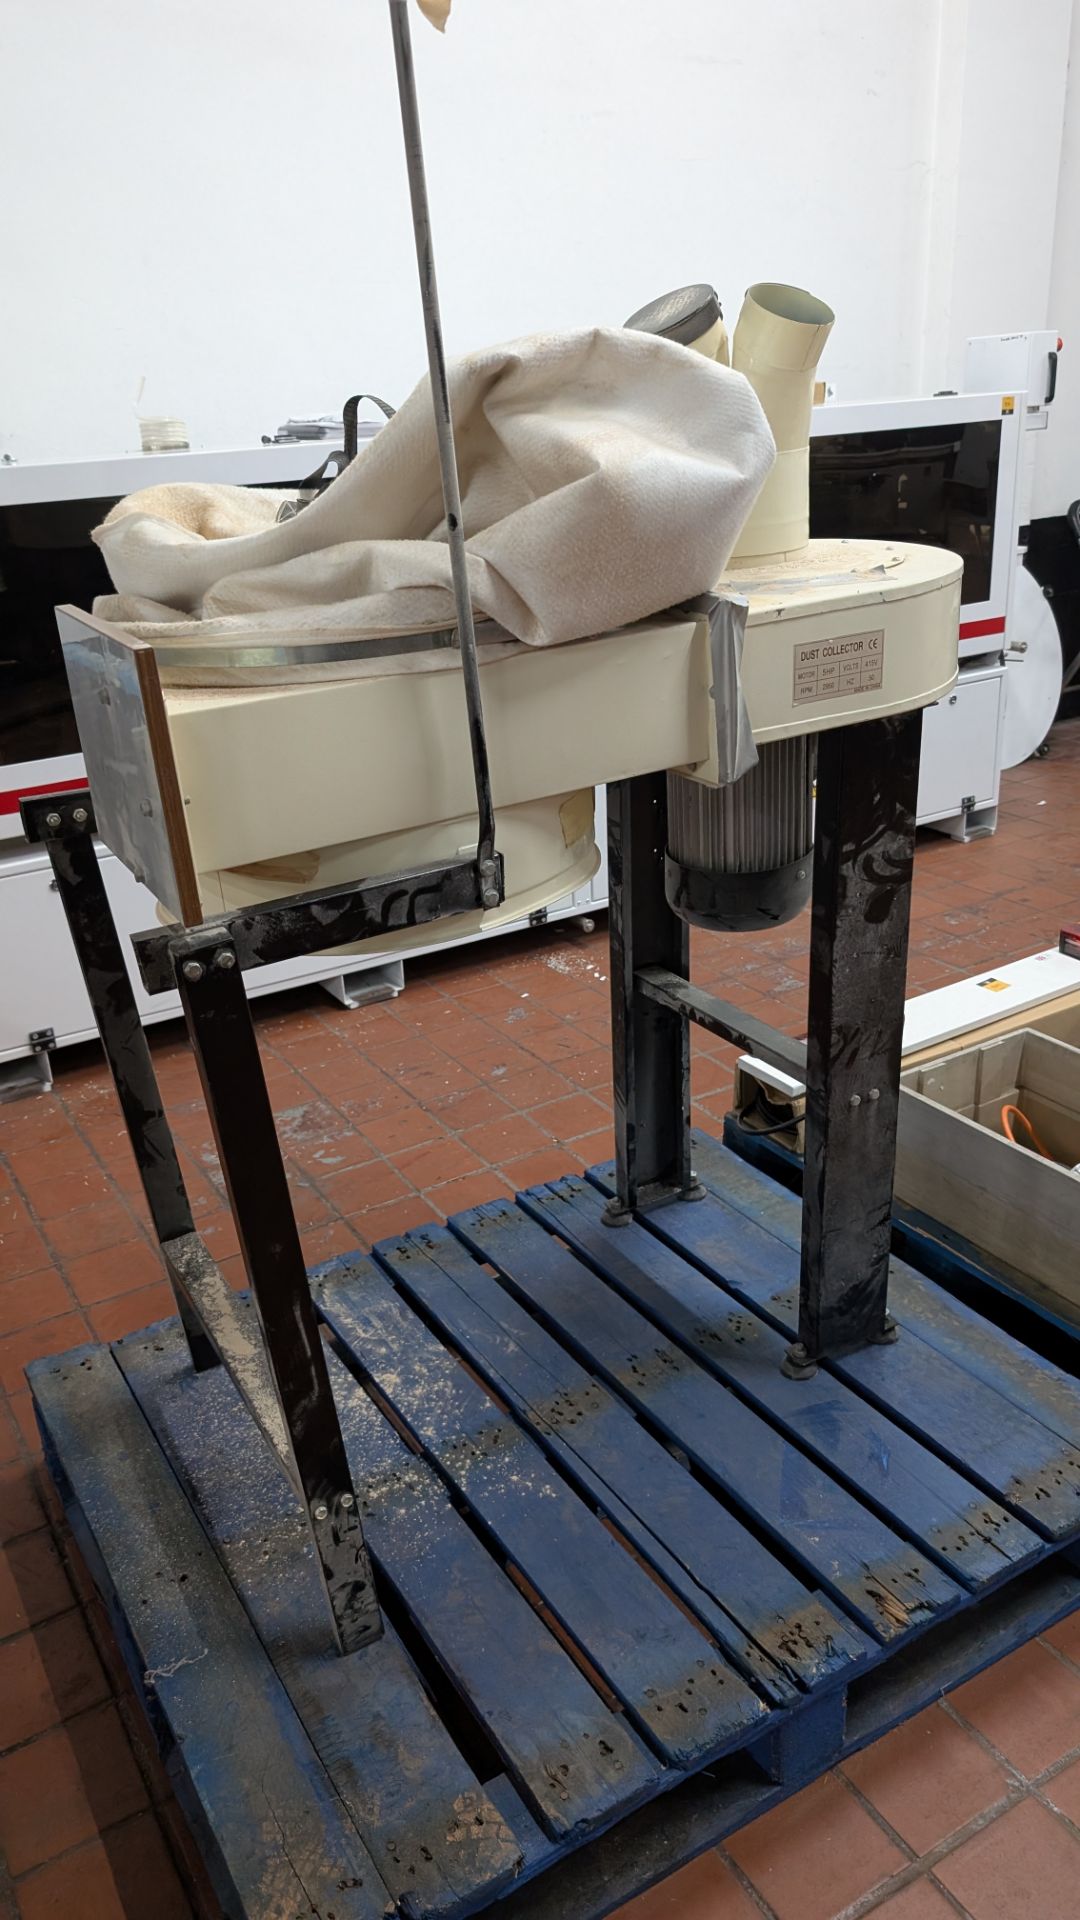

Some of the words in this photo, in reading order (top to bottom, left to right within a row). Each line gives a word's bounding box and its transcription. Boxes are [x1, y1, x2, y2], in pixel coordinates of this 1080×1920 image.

[801, 649, 819, 661] DUST
[822, 641, 864, 657] COLLECTOR
[868, 638, 878, 650] CE
[798, 671, 815, 680] MOTOR
[822, 667, 835, 676] 5HP
[843, 662, 859, 671] VOLTS
[865, 659, 878, 667] 415V
[800, 686, 813, 696] RPM
